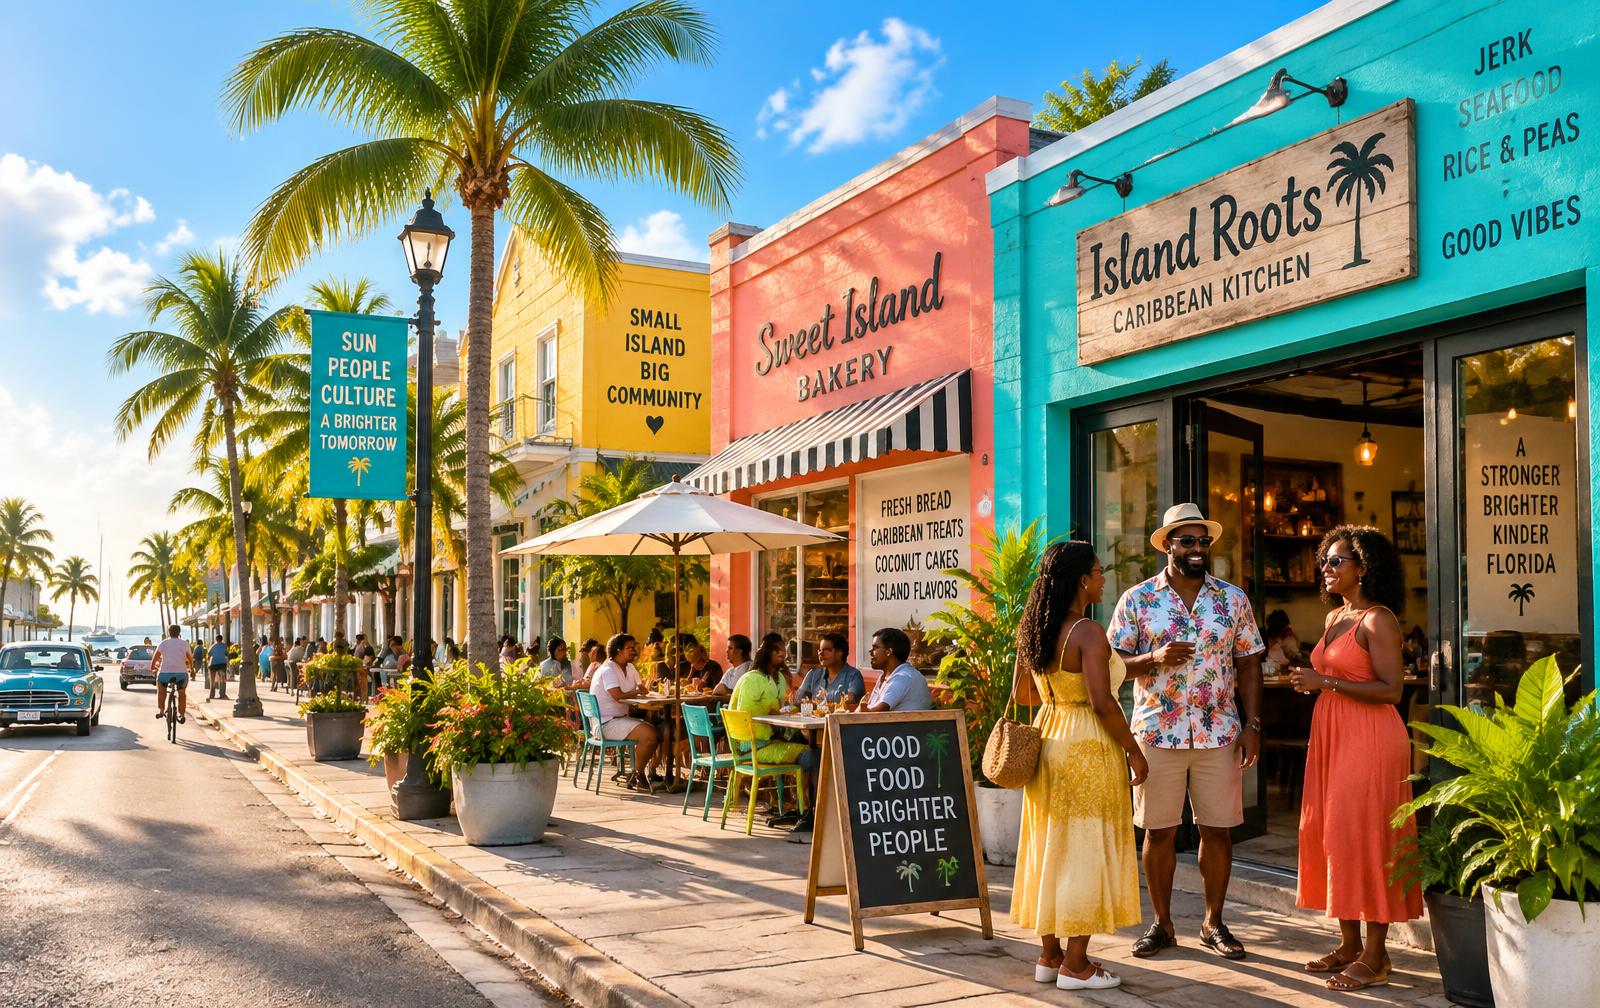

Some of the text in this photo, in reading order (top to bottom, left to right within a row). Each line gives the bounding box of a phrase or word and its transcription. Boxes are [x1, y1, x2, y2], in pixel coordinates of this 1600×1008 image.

[1474, 27, 1534, 76] JERK
[1458, 64, 1563, 129] SEAFOOD
[1443, 112, 1580, 182] RICE & PEAS
[1089, 175, 1322, 301] Island Roots
[1442, 194, 1581, 260] GOOD VIBES
[1113, 251, 1311, 333] CARIBBEAN KITCHEN
[630, 308, 682, 331] SMALL
[755, 251, 944, 376] Sweet Island
[341, 331, 377, 353] SUN
[625, 333, 685, 357] ISLAND
[328, 357, 391, 381] PEOPLE
[640, 361, 670, 381] BIG
[797, 345, 893, 402] BAKERY
[321, 384, 397, 408] CULTURE
[607, 385, 702, 410] COMMUNITY
[320, 413, 397, 431] A BRIGHTER
[320, 434, 397, 451] TOMORROW
[1515, 436, 1526, 457] A
[1481, 464, 1561, 487] STRONGER
[881, 490, 952, 518] FRESH BREAD
[1483, 494, 1559, 517] BRIGHTER
[871, 518, 964, 547] CARIBBEAN TREATS
[1493, 524, 1549, 545] KINDER
[875, 549, 959, 573] COCONUT CAKES
[1487, 552, 1556, 575] FLORIDA
[876, 579, 958, 601] ISLAND FLAVORS
[861, 735, 921, 761] GOOD
[866, 766, 925, 792] FOOD
[858, 795, 957, 825] BRIGHTER
[869, 828, 948, 857] PEOPLE
